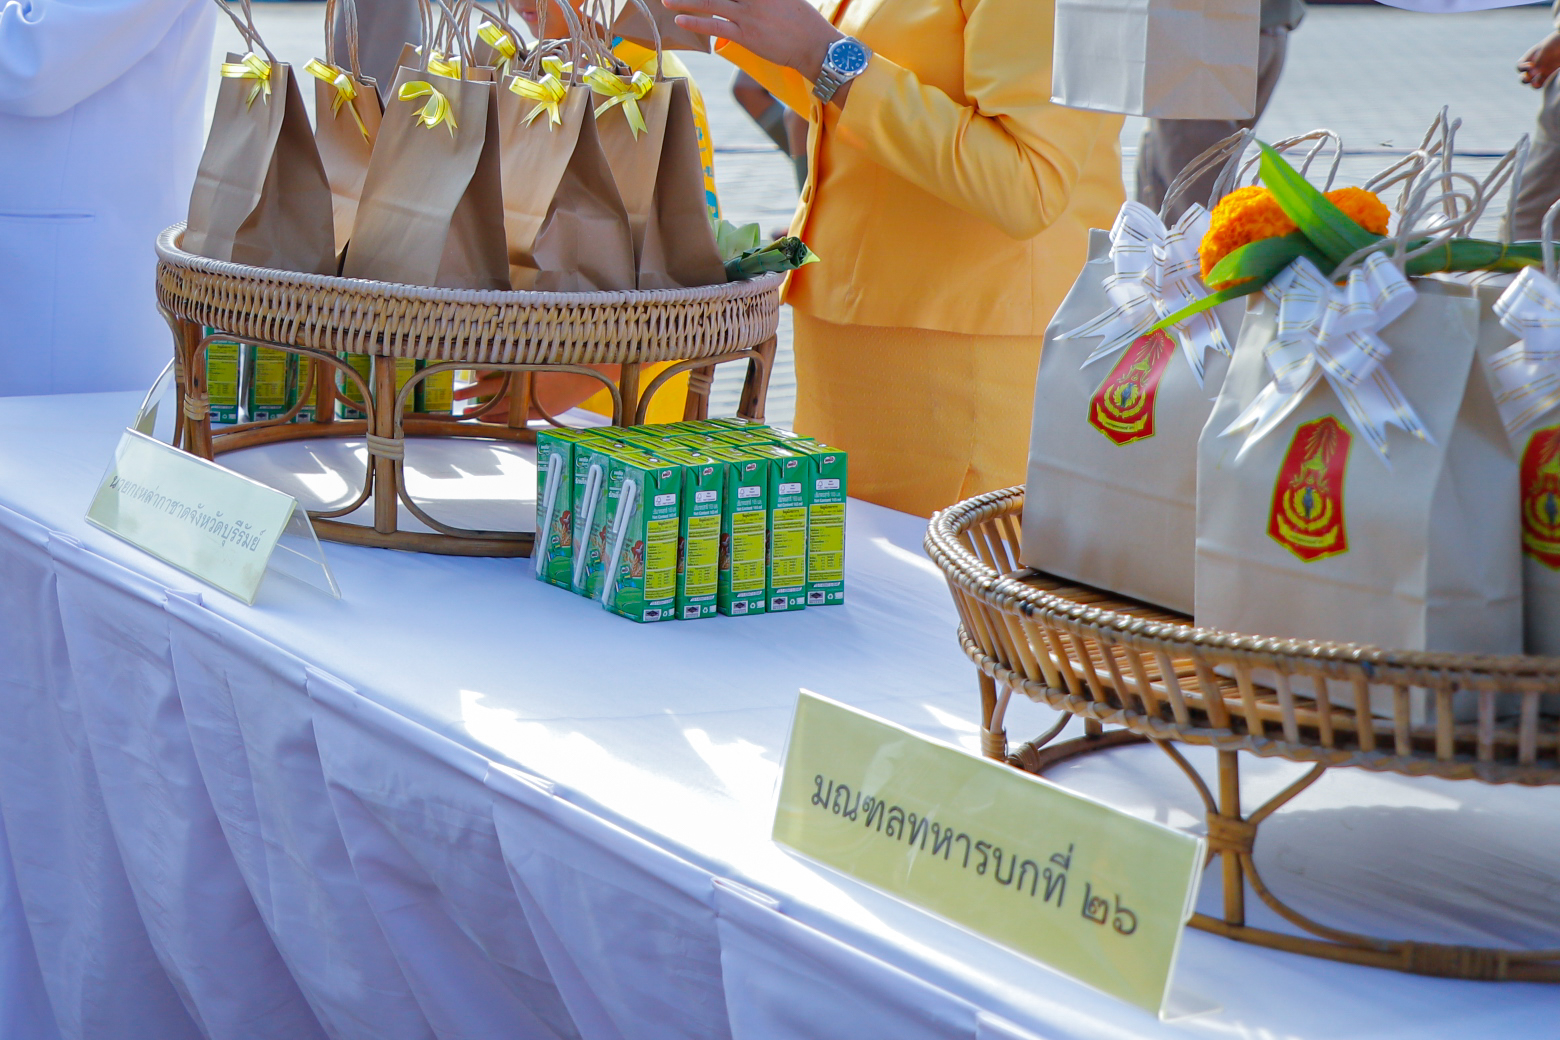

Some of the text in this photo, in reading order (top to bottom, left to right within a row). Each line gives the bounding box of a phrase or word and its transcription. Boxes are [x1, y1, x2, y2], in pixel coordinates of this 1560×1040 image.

[109, 475, 267, 552] นายกเหล่ากาชาดจังหวัดบุรีรัมย์
[810, 773, 1139, 936] มณฑลทหารบกที่ ๒๖
